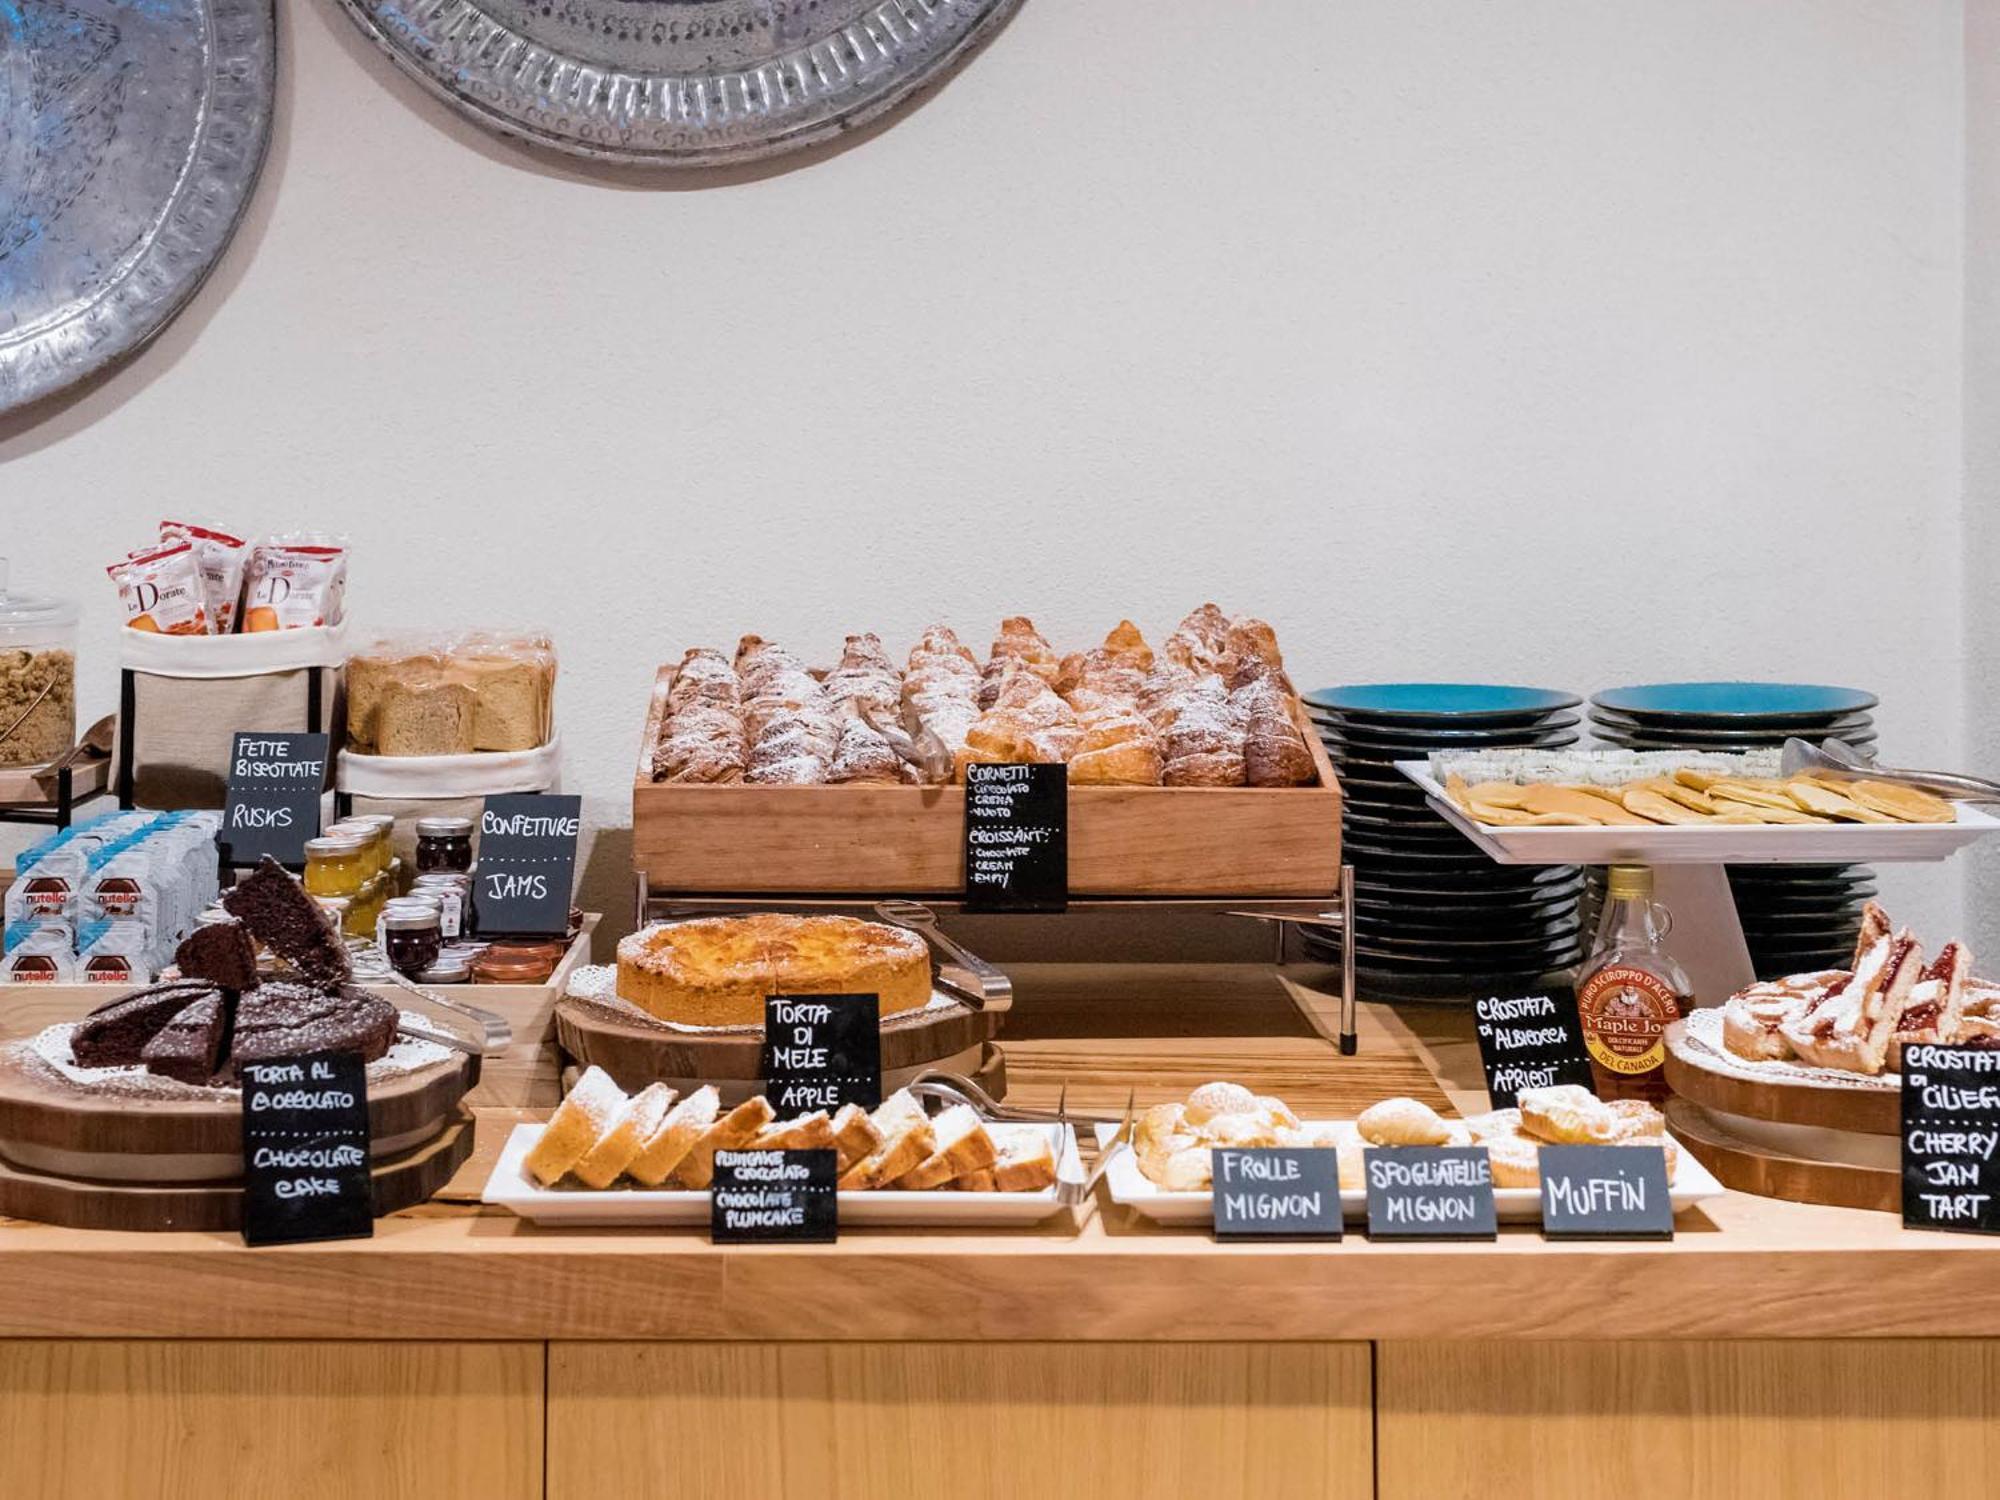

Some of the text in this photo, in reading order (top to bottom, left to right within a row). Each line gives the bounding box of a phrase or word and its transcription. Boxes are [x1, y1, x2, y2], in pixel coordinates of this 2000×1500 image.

[136, 582, 186, 612] Dorate
[238, 738, 291, 757] FETTE
[235, 759, 323, 778] BISCOTTATE
[232, 803, 293, 829] RUSKS
[482, 810, 579, 837] CONFETTURE
[26, 893, 67, 904] nutella
[98, 893, 138, 904] nutella
[485, 873, 548, 900] JAMS
[14, 971, 55, 982] nutella
[87, 971, 129, 982] nutella
[1582, 969, 1677, 1015] PURO SCIROPPO D'ACERO
[769, 1000, 832, 1024] TORTA
[1476, 996, 1556, 1021] CROSTATA
[793, 1026, 813, 1046] DI
[1585, 1014, 1664, 1034] Maple Jo
[1495, 1026, 1568, 1051] ALBICOCCA
[773, 1046, 828, 1070] MELE
[1598, 1051, 1660, 1072] DEL CANADA
[1906, 1045, 2000, 1072] CROSTAT
[243, 1061, 336, 1083] TORTA AL
[1493, 1066, 1559, 1092] APRICOT
[780, 1086, 839, 1108] APPLE
[1922, 1084, 2000, 1110] CILIEGI
[253, 1145, 365, 1168] CHOCOLATE
[1908, 1130, 1999, 1161] CHERRY
[1221, 1152, 1302, 1183] FROLLE
[1369, 1159, 1490, 1189] SFOGLIATELLE
[1924, 1160, 1979, 1186] JAM
[274, 1176, 340, 1199] CAKE
[1546, 1170, 1646, 1216] MUFFIN
[725, 1207, 805, 1229] PLUMCAKE
[1224, 1191, 1321, 1221] MIGNON
[1386, 1195, 1475, 1224] MIGNON
[1919, 1194, 1991, 1220] TART
